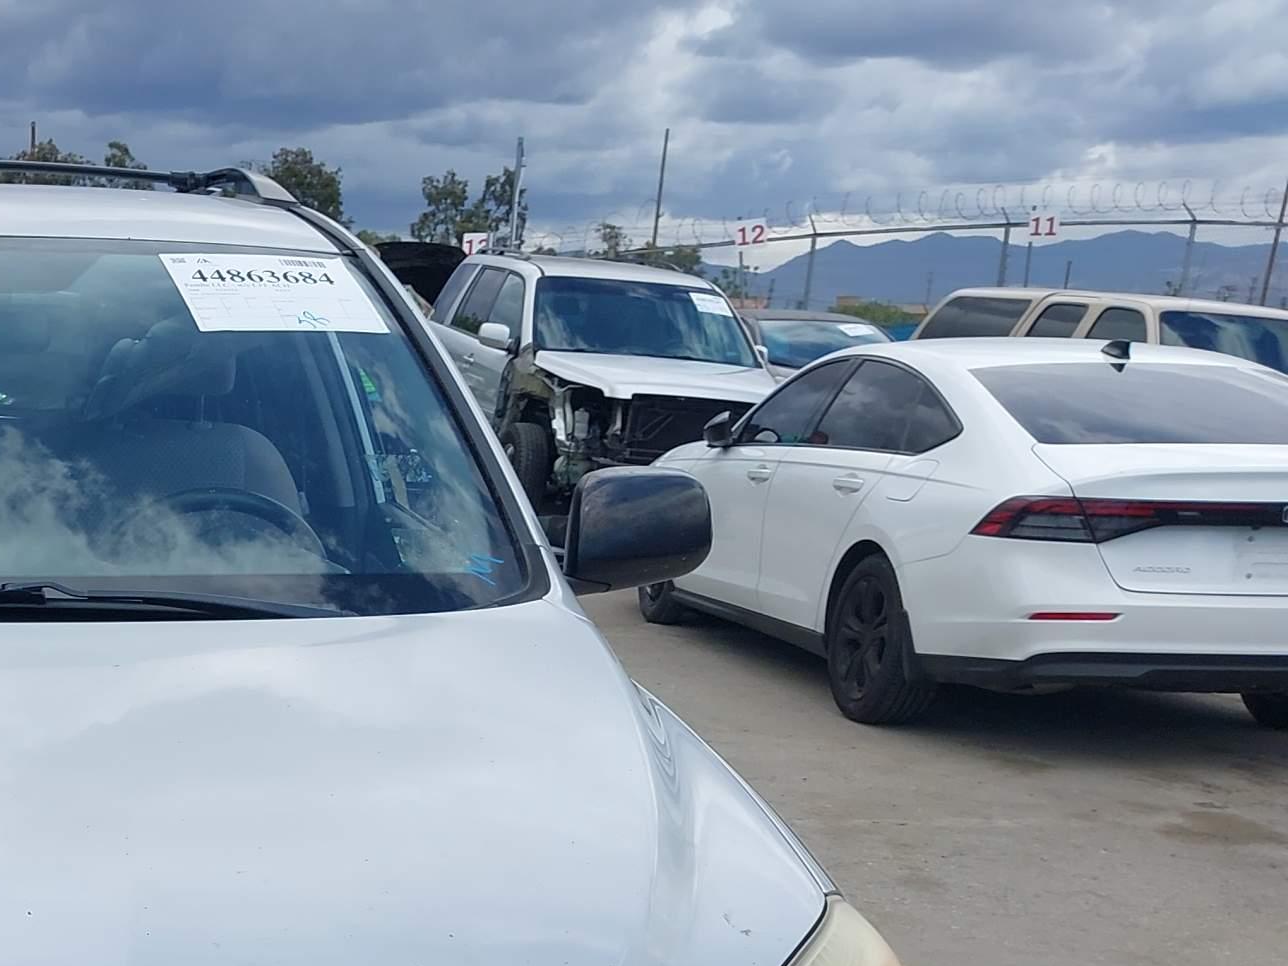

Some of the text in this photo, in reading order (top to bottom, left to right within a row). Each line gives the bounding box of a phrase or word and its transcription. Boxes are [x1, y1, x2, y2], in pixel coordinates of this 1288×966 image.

[738, 225, 764, 245] 12
[1030, 217, 1056, 236] 11
[192, 269, 334, 285] 44863684
